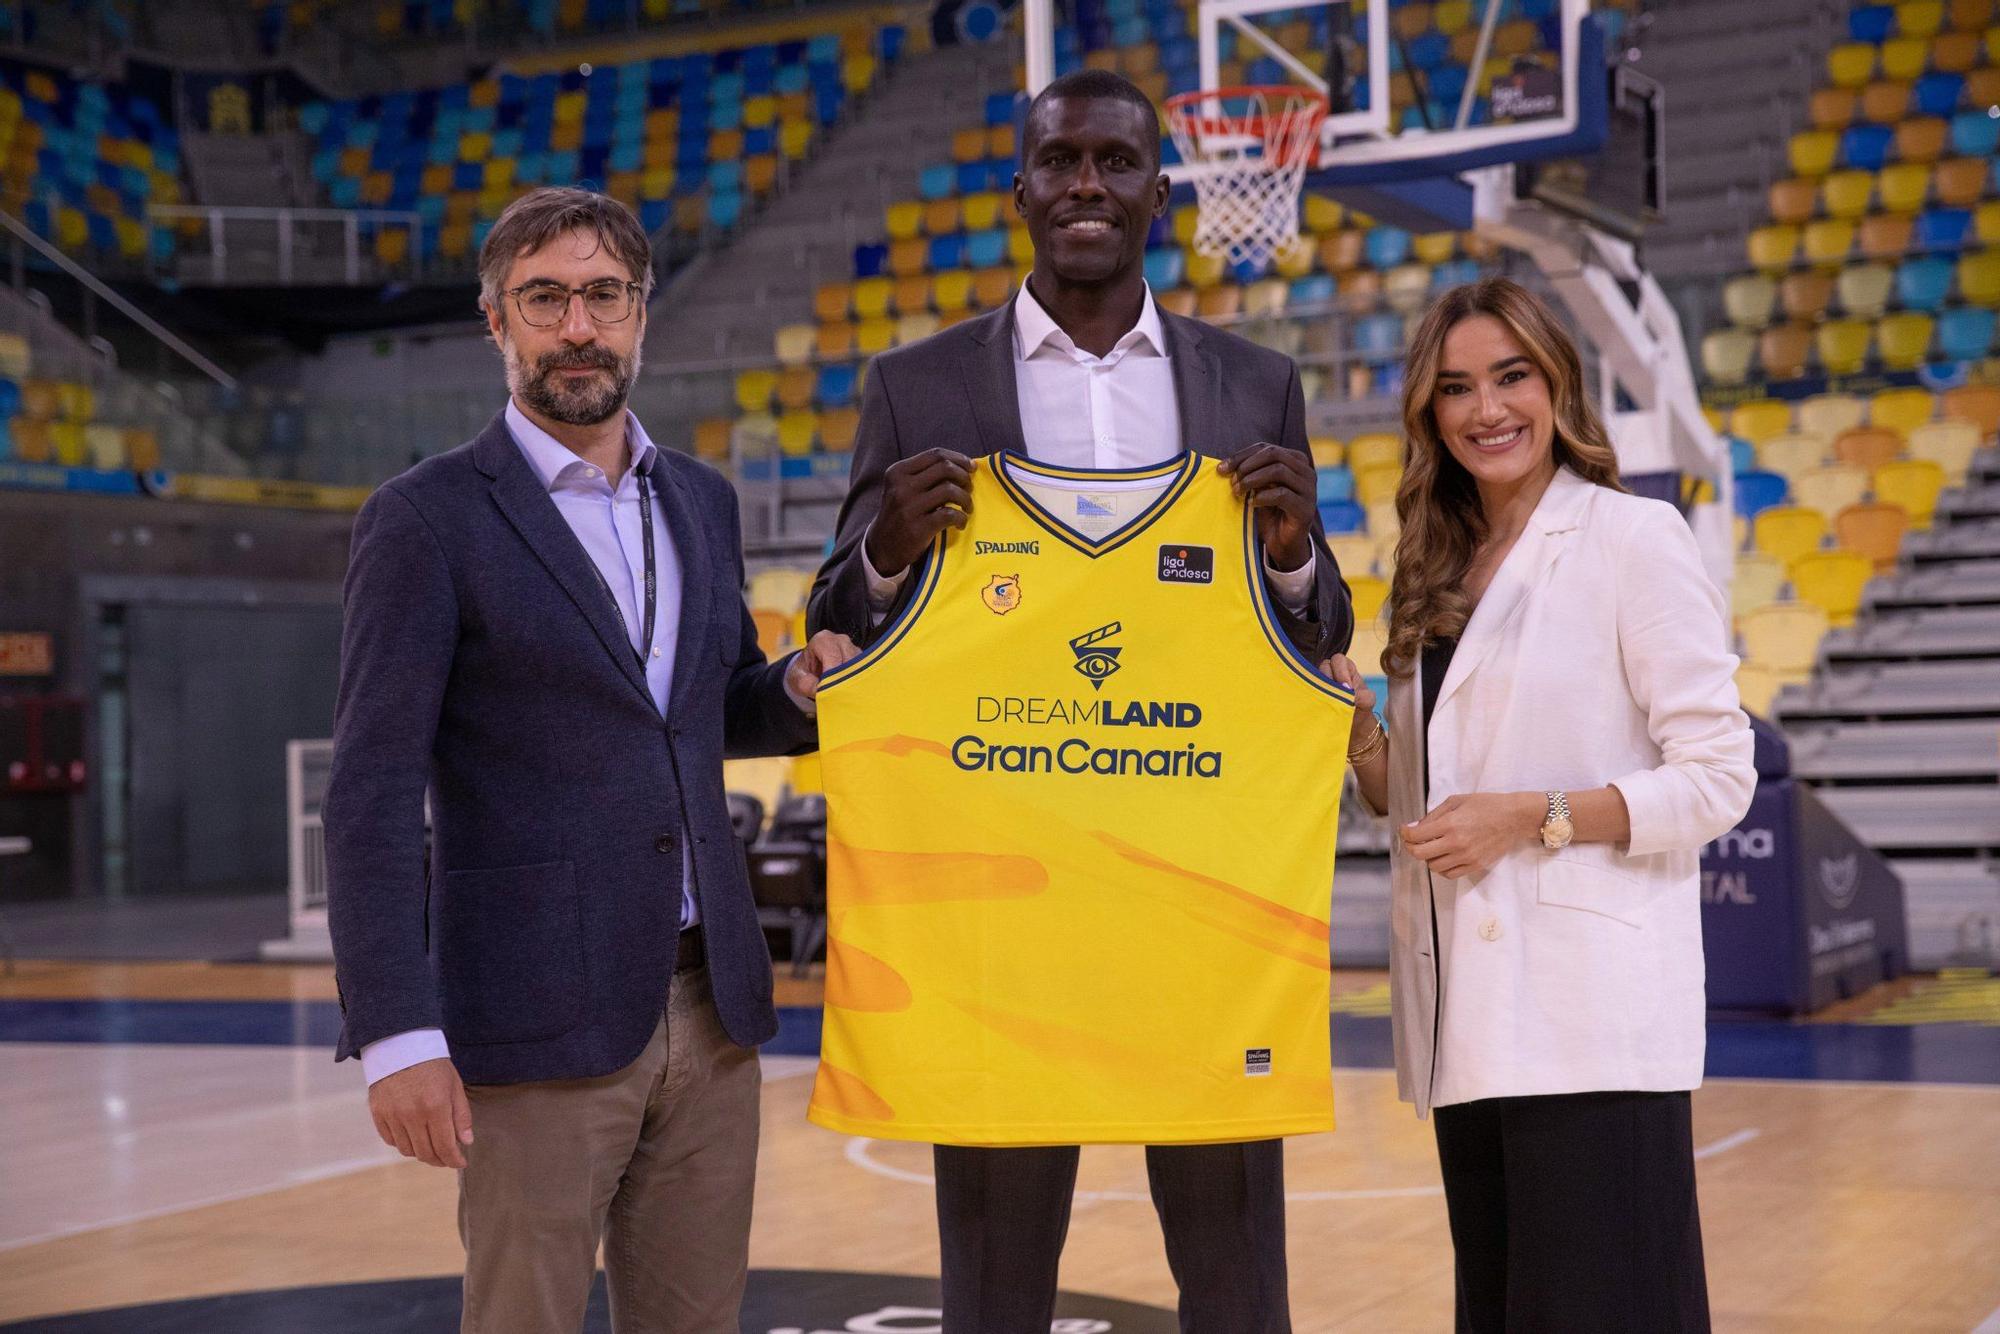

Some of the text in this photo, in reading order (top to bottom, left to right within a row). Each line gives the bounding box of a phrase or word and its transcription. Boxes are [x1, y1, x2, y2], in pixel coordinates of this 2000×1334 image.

[976, 541, 1039, 555] SPALDING
[1163, 556, 1185, 568] liga
[1163, 568, 1209, 579] endesa
[977, 697, 1202, 728] DREAMLAND
[952, 735, 1222, 777] Gran Canaria
